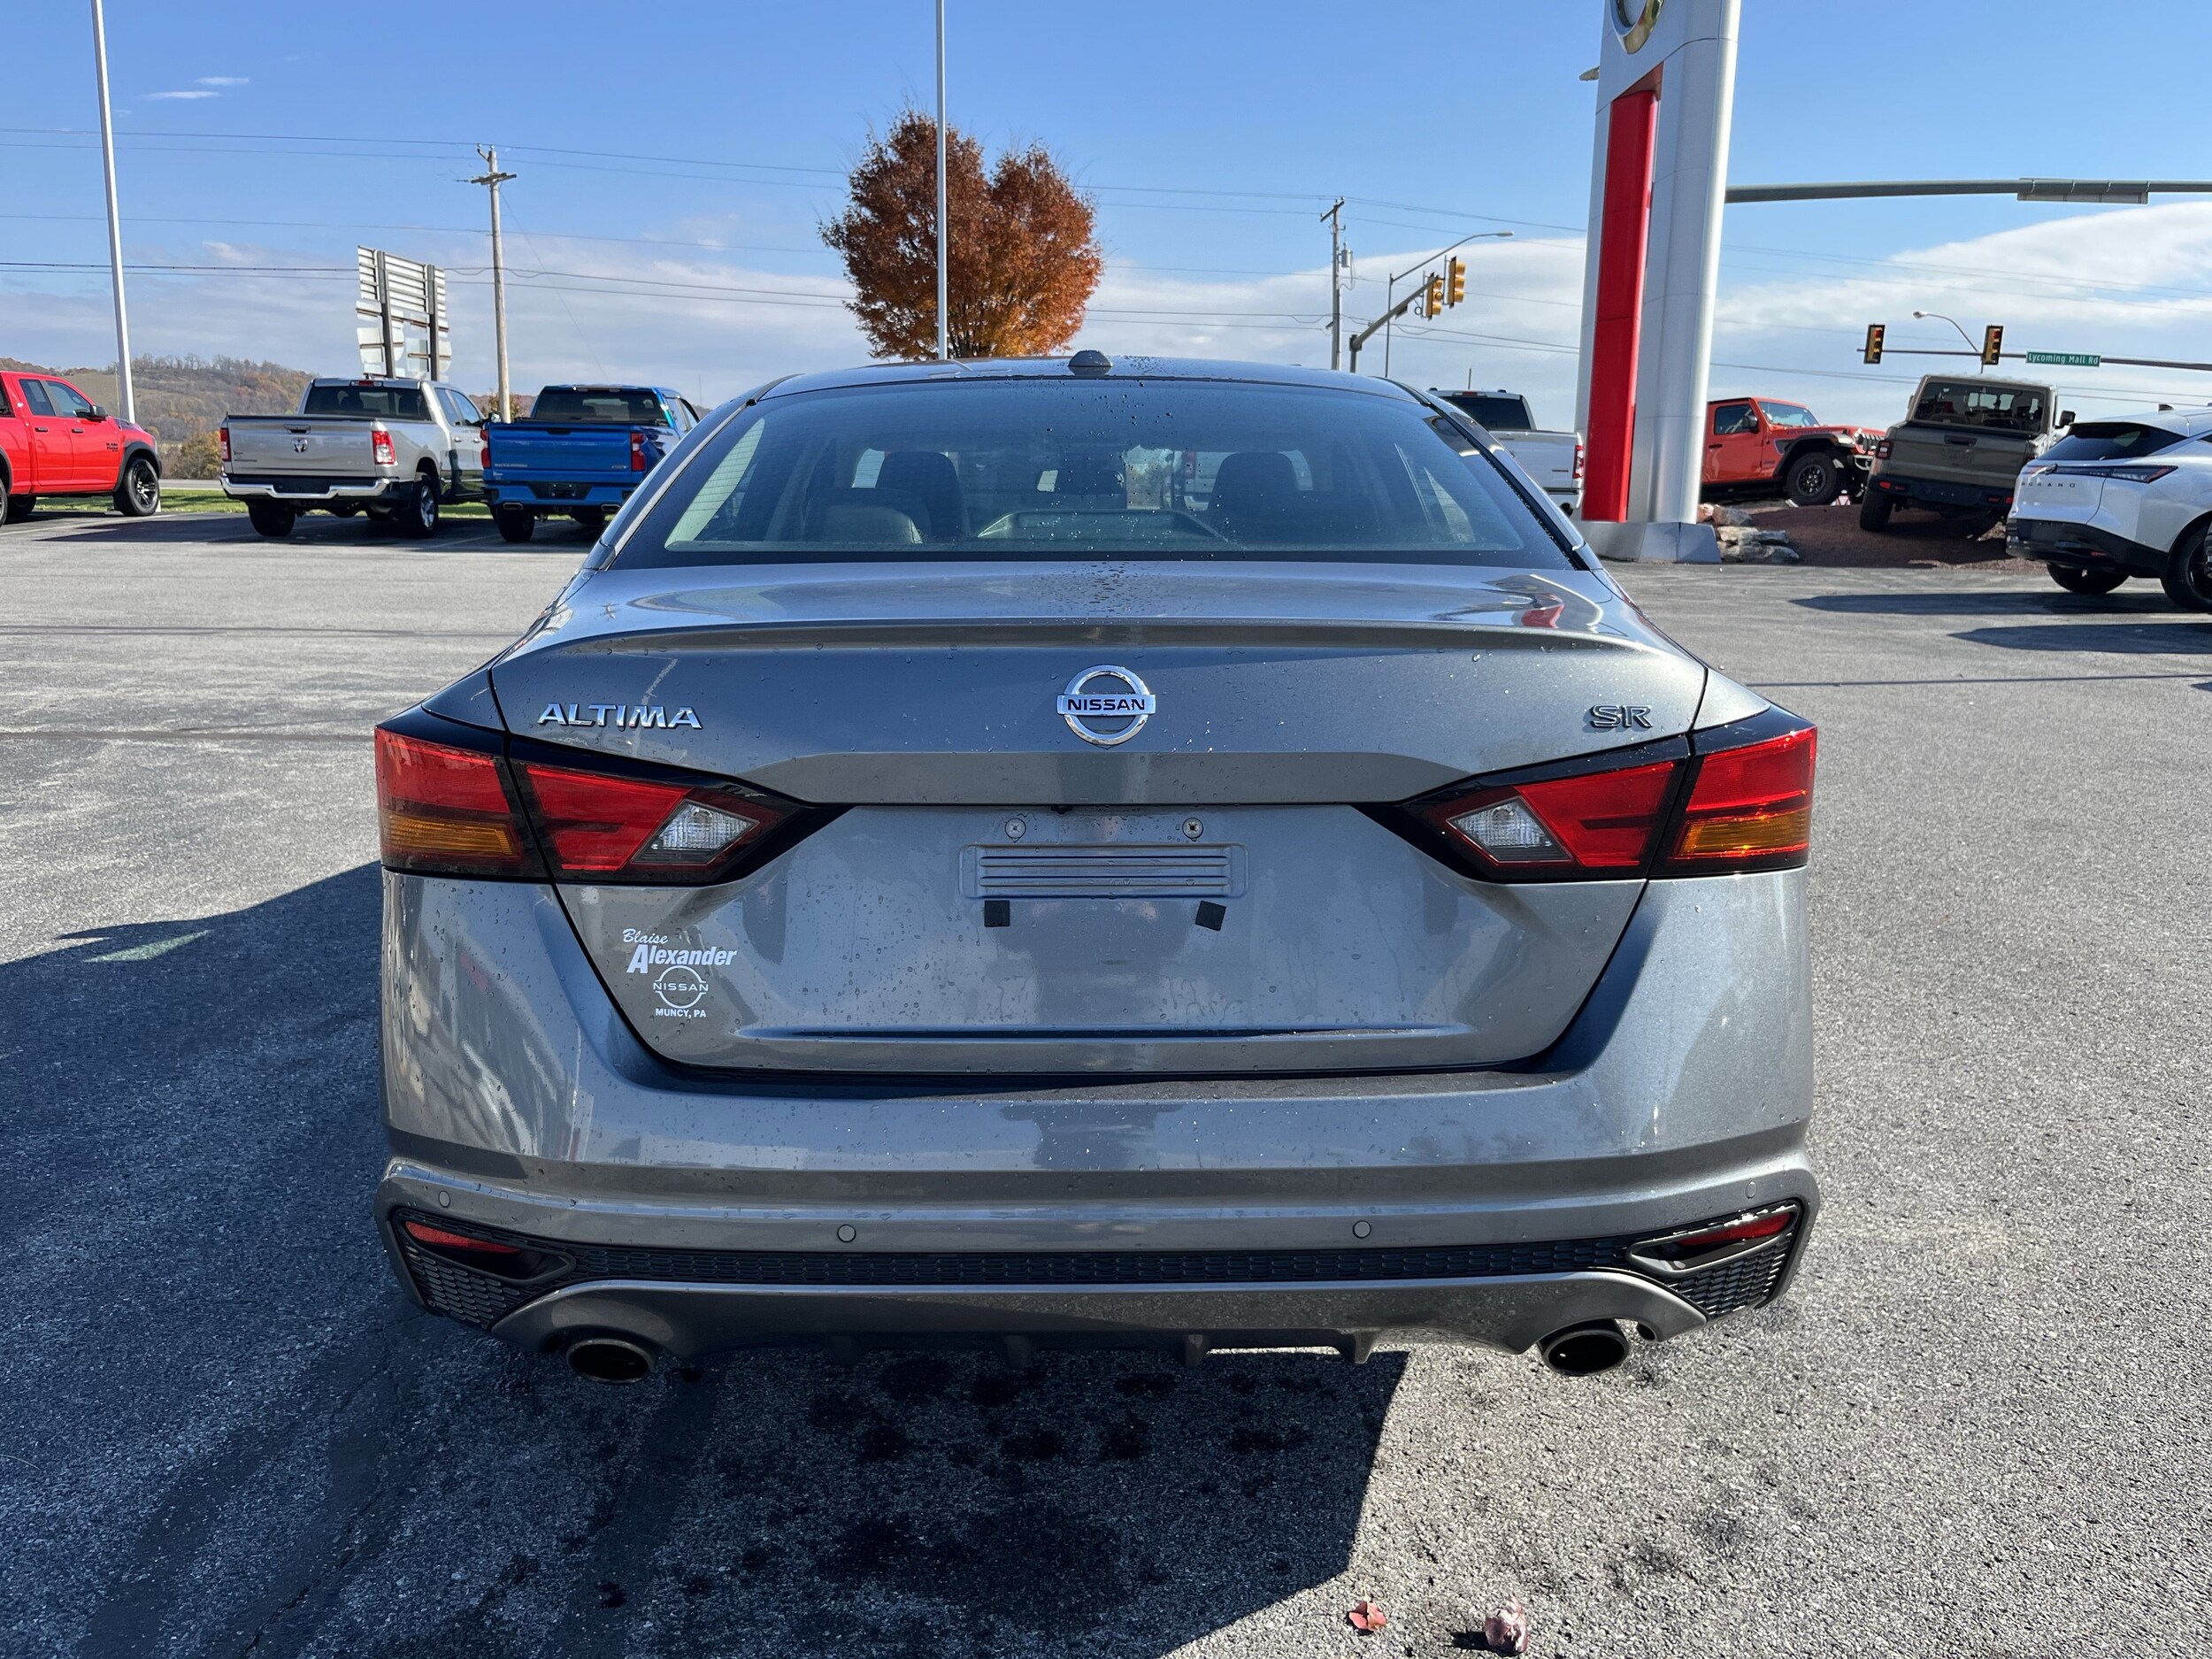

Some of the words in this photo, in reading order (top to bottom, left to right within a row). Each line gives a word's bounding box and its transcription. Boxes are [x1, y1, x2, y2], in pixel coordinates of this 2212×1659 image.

[2028, 353, 2066, 365] Lycoming
[2069, 356, 2085, 365] Mall
[1067, 698, 1145, 710] NISSAN
[537, 702, 703, 729] ALTIMA
[1590, 704, 1653, 728] SR
[622, 928, 669, 944] Blaise
[626, 943, 738, 974] Alexander
[653, 982, 709, 992] NISSAN
[655, 1008, 692, 1018] MUNCY,
[694, 1009, 707, 1018] PA
